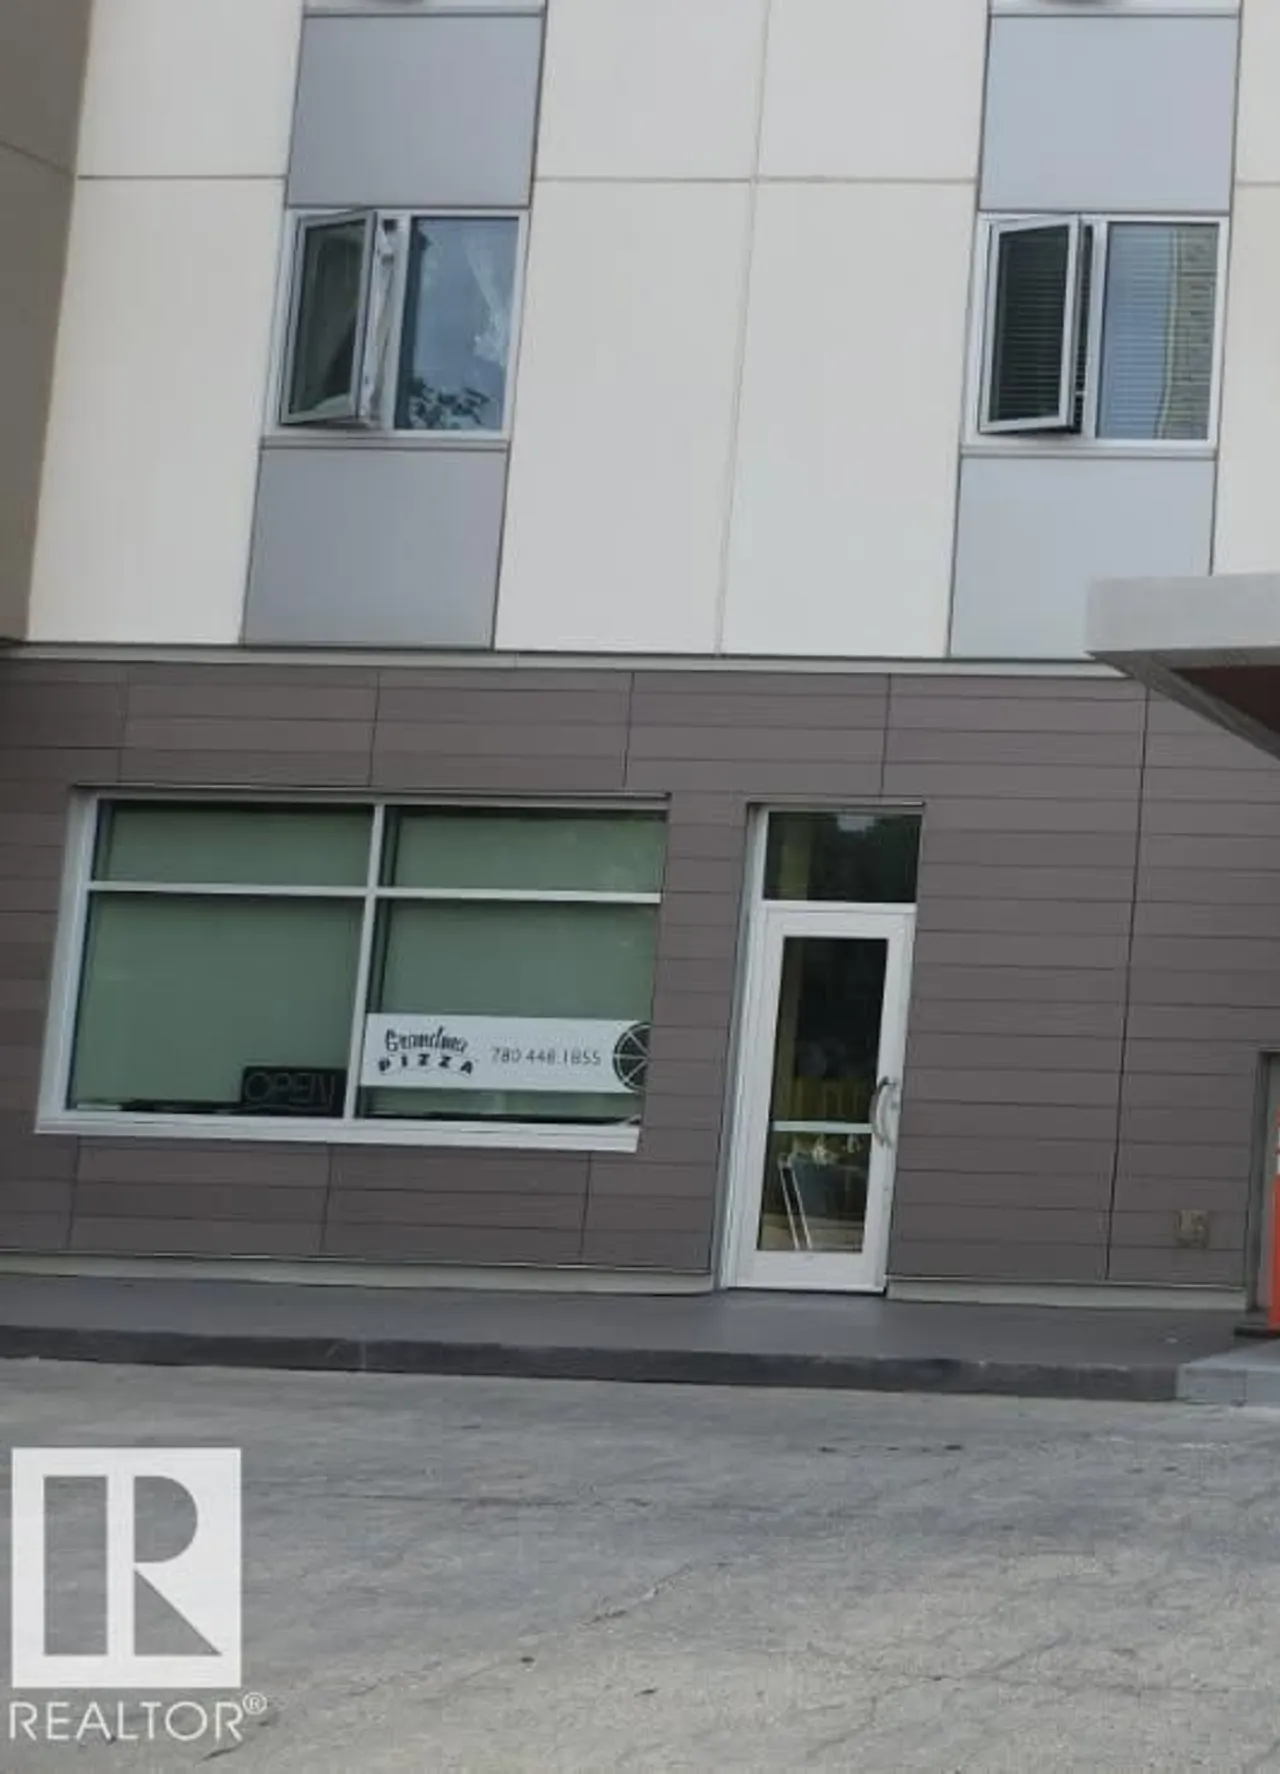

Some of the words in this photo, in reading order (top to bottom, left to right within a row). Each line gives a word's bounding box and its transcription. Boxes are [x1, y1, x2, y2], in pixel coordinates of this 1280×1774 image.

[385, 1025, 469, 1054] Grandma
[378, 1053, 474, 1075] PIZZA
[491, 1046, 521, 1065] 780
[244, 1071, 335, 1104] OPEN
